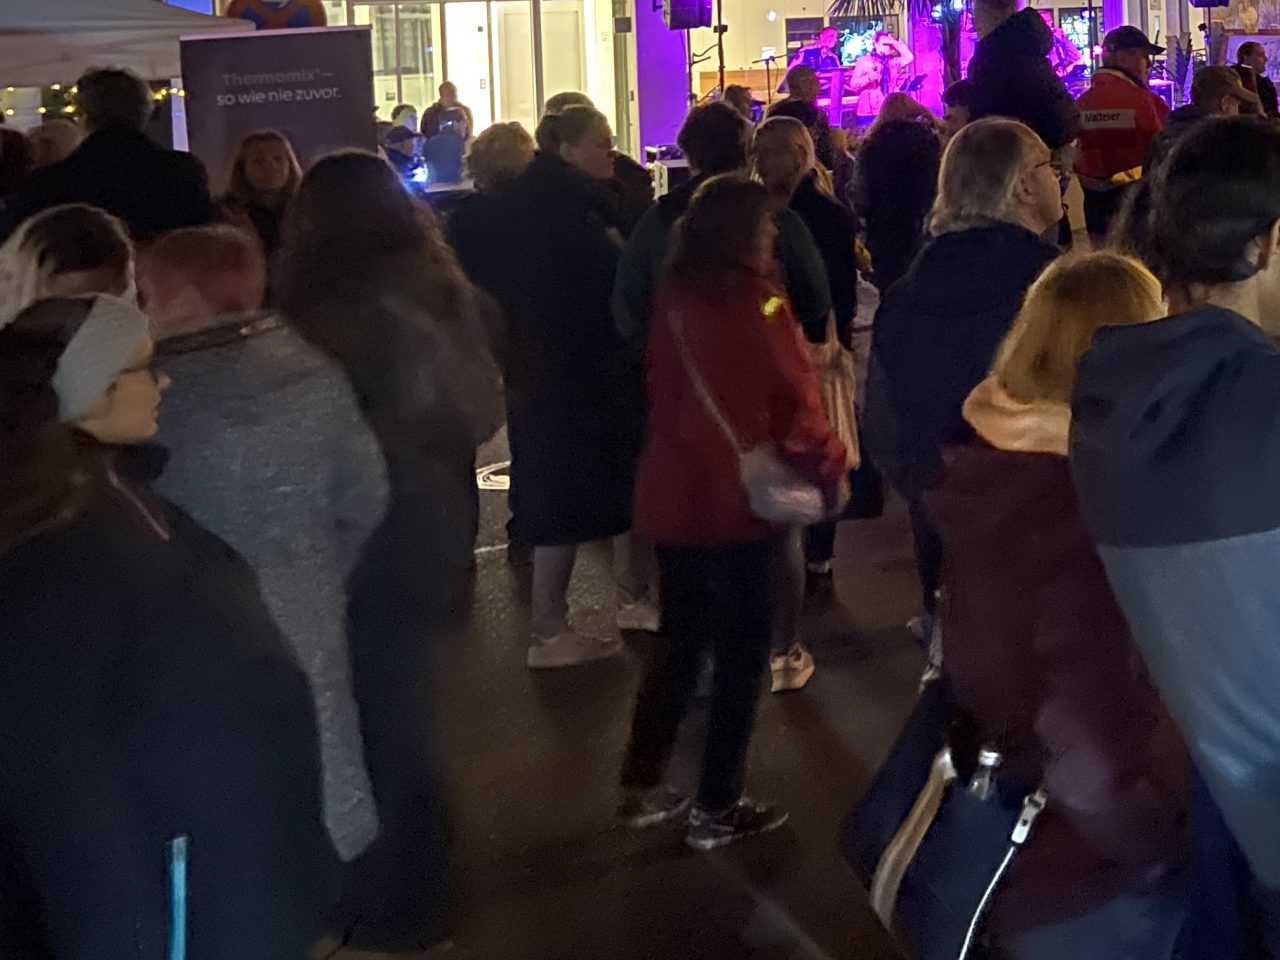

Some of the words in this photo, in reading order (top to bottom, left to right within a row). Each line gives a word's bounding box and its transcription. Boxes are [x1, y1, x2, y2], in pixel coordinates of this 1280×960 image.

[216, 93, 236, 106] so
[238, 90, 266, 104] wie
[268, 88, 293, 102] nie
[295, 87, 342, 101] zuvor.
[1085, 111, 1120, 122] Malteser
